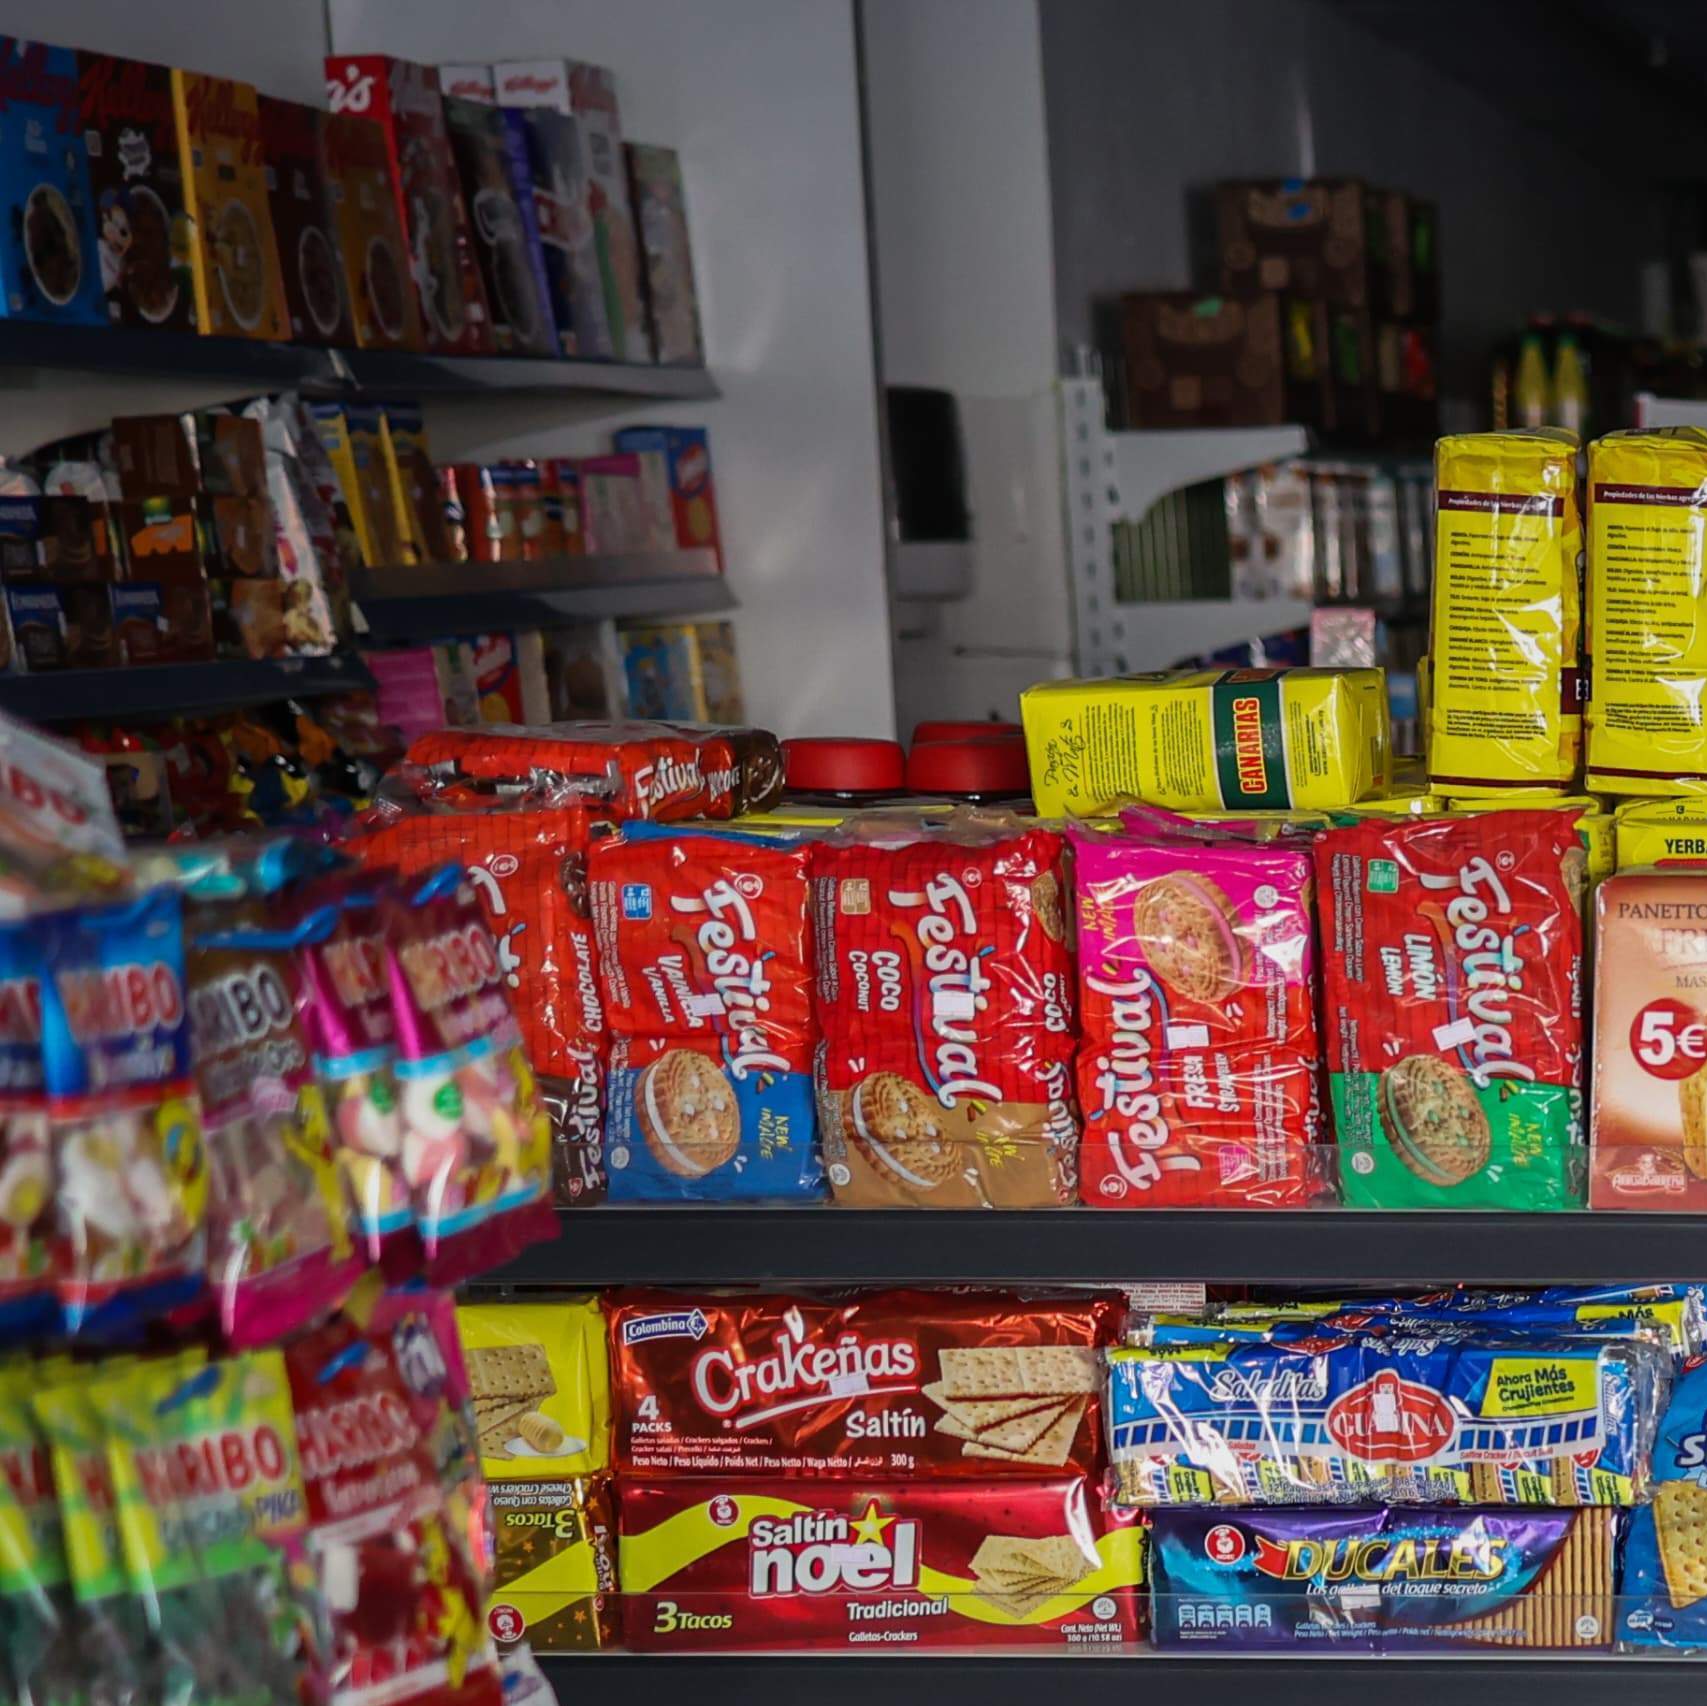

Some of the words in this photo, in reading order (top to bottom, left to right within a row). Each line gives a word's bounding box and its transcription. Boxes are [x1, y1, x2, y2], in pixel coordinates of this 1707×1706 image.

[1235, 695, 1261, 795] CANARIAS
[574, 931, 602, 1032] CHOCOLATE
[671, 878, 791, 1081] Festival
[847, 950, 870, 1013] COCONUT
[870, 950, 901, 1010] COCO
[1380, 946, 1405, 997] LEMON
[1403, 933, 1438, 1002] LIMÓN
[1418, 856, 1536, 1089] Festival
[640, 965, 673, 1024] VANILLA
[1087, 964, 1202, 1190] Festival
[1182, 1054, 1205, 1110] FRESA
[566, 1044, 602, 1190] Festival
[627, 1316, 687, 1339] Colombina
[690, 1306, 918, 1415] Crakeñas
[1497, 1372, 1533, 1388] Ahora
[1535, 1367, 1567, 1385] Más
[1210, 1368, 1330, 1402] Saladitas
[1498, 1382, 1576, 1403] Crujientes
[631, 1421, 673, 1434] PACKS
[637, 1394, 662, 1422] 4
[845, 1408, 927, 1441] Saltín
[1327, 1408, 1450, 1443] GUAINA
[632, 1454, 655, 1467] Peso
[656, 1455, 670, 1467] Neto
[752, 1513, 848, 1550] Saltín
[751, 1518, 921, 1598] noel
[1282, 1537, 1504, 1582] DUCALES
[846, 1598, 950, 1623] Tradicional
[1382, 1581, 1404, 1597] del
[1406, 1581, 1435, 1600] toque
[1438, 1582, 1489, 1597] secreto
[677, 1611, 734, 1631] Tacos
